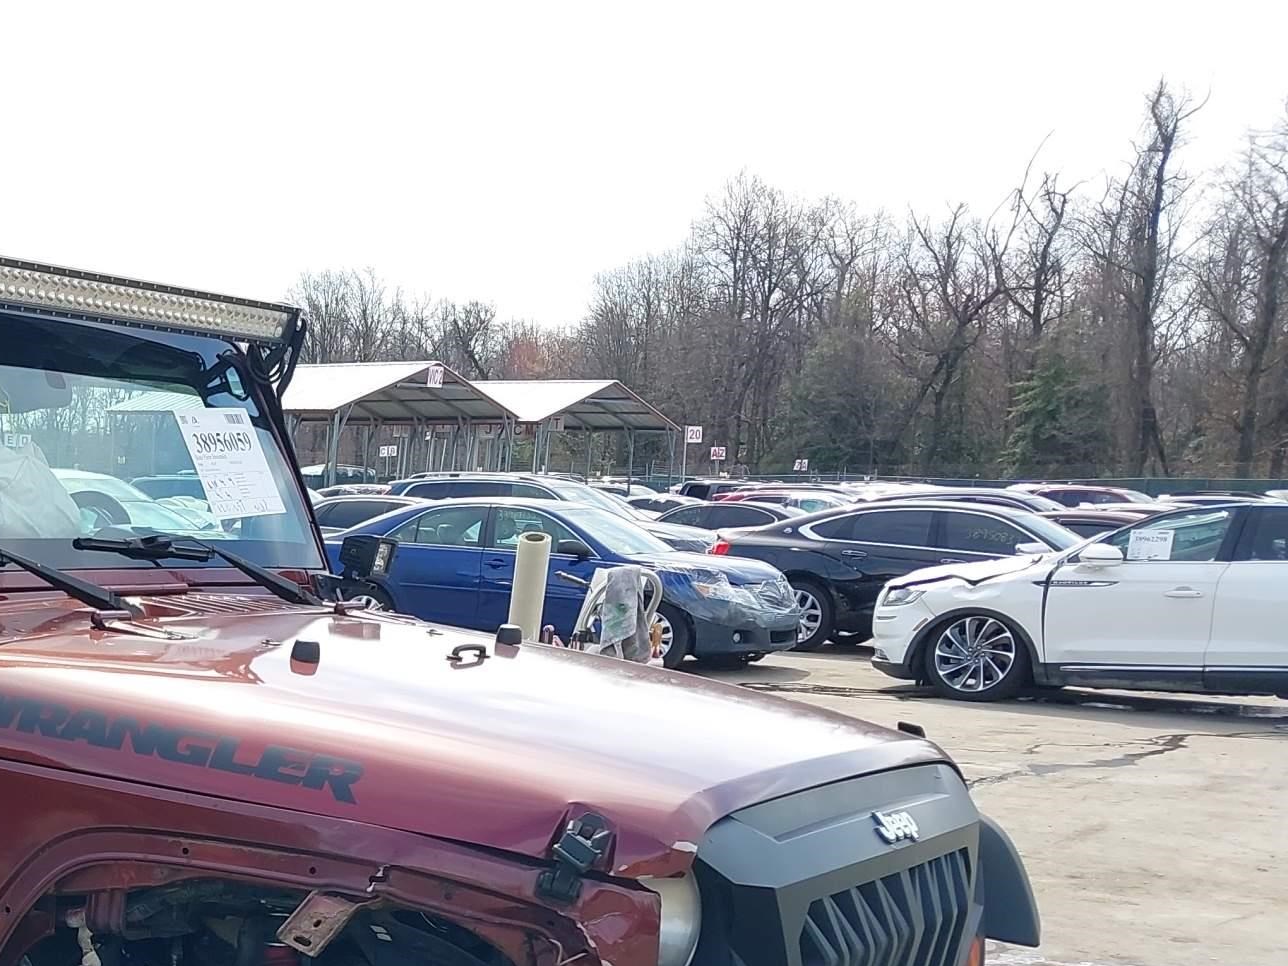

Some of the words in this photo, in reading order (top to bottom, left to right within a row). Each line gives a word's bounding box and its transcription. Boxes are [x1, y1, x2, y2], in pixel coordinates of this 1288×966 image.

[191, 431, 253, 454] 38956059
[688, 429, 702, 440] 20
[871, 811, 920, 843] Jeep
